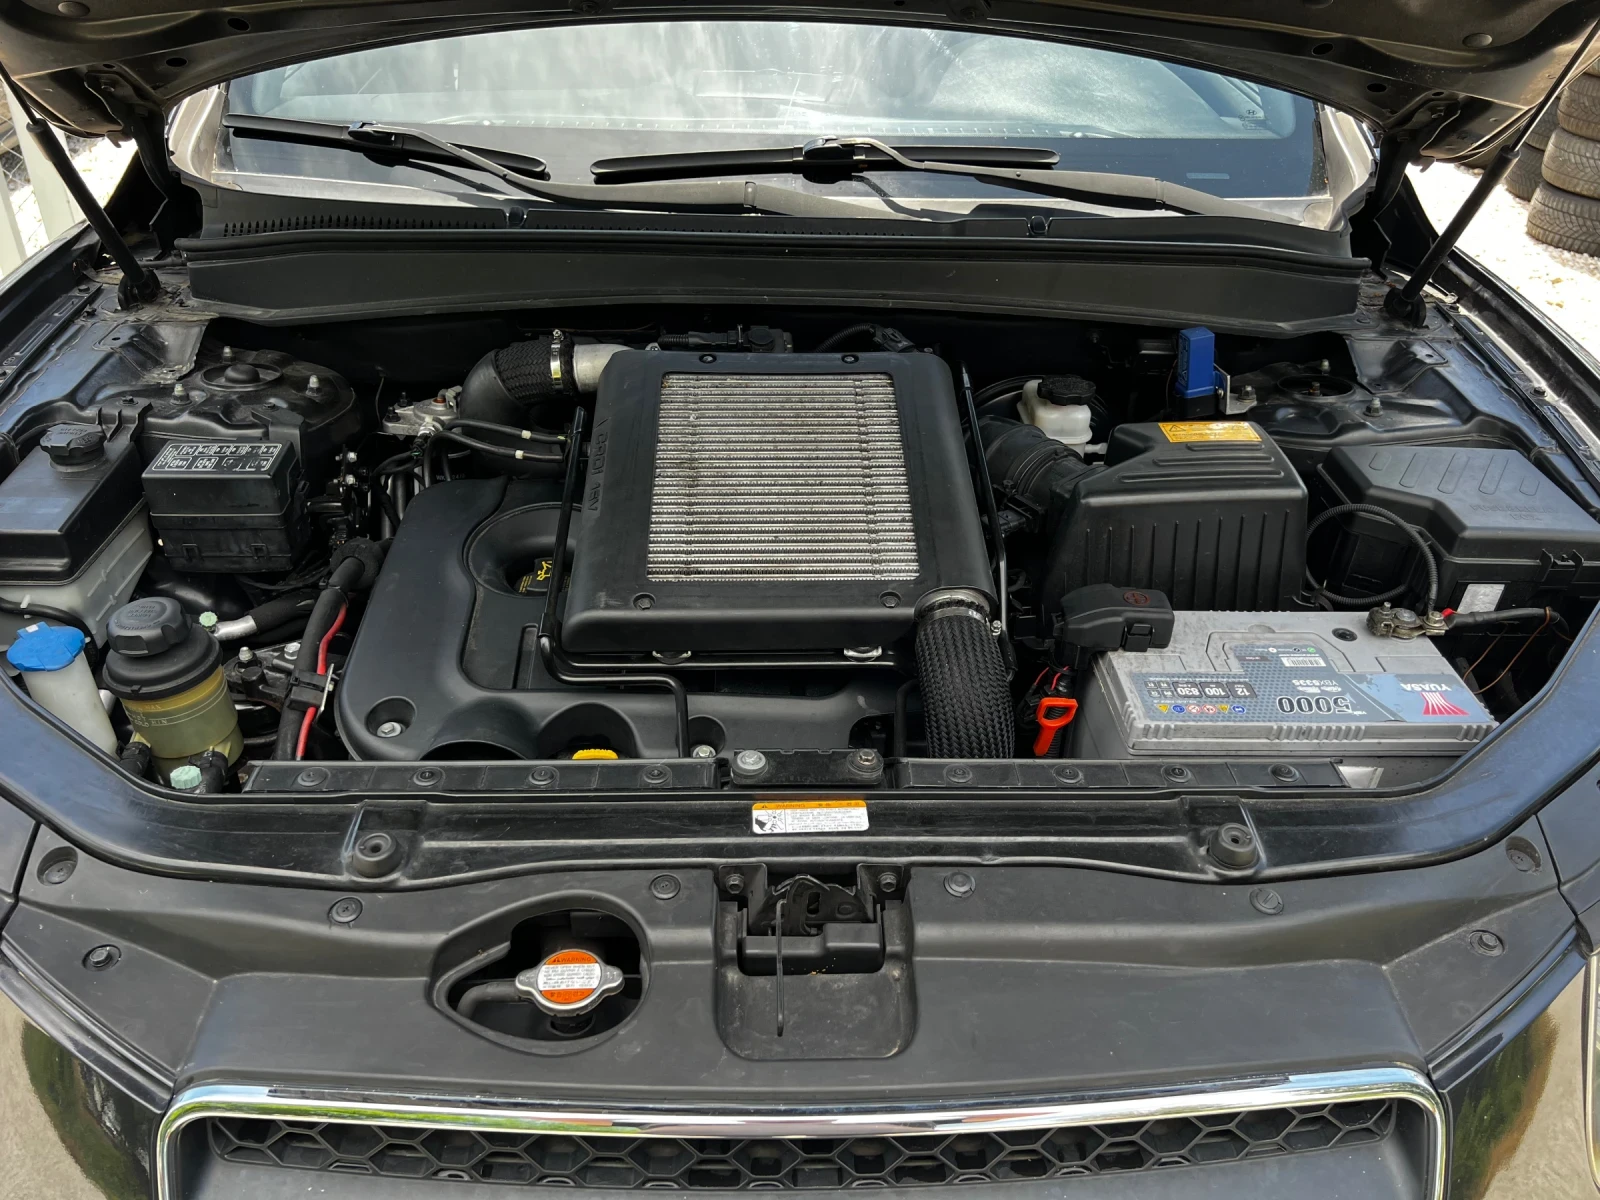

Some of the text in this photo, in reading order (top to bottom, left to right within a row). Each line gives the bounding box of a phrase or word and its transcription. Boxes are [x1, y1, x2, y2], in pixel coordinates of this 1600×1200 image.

[1177, 687, 1199, 696] 830
[1205, 687, 1226, 696] 100
[1235, 687, 1250, 696] 12
[1400, 683, 1452, 691] YUASA
[1276, 695, 1352, 715] 5000
